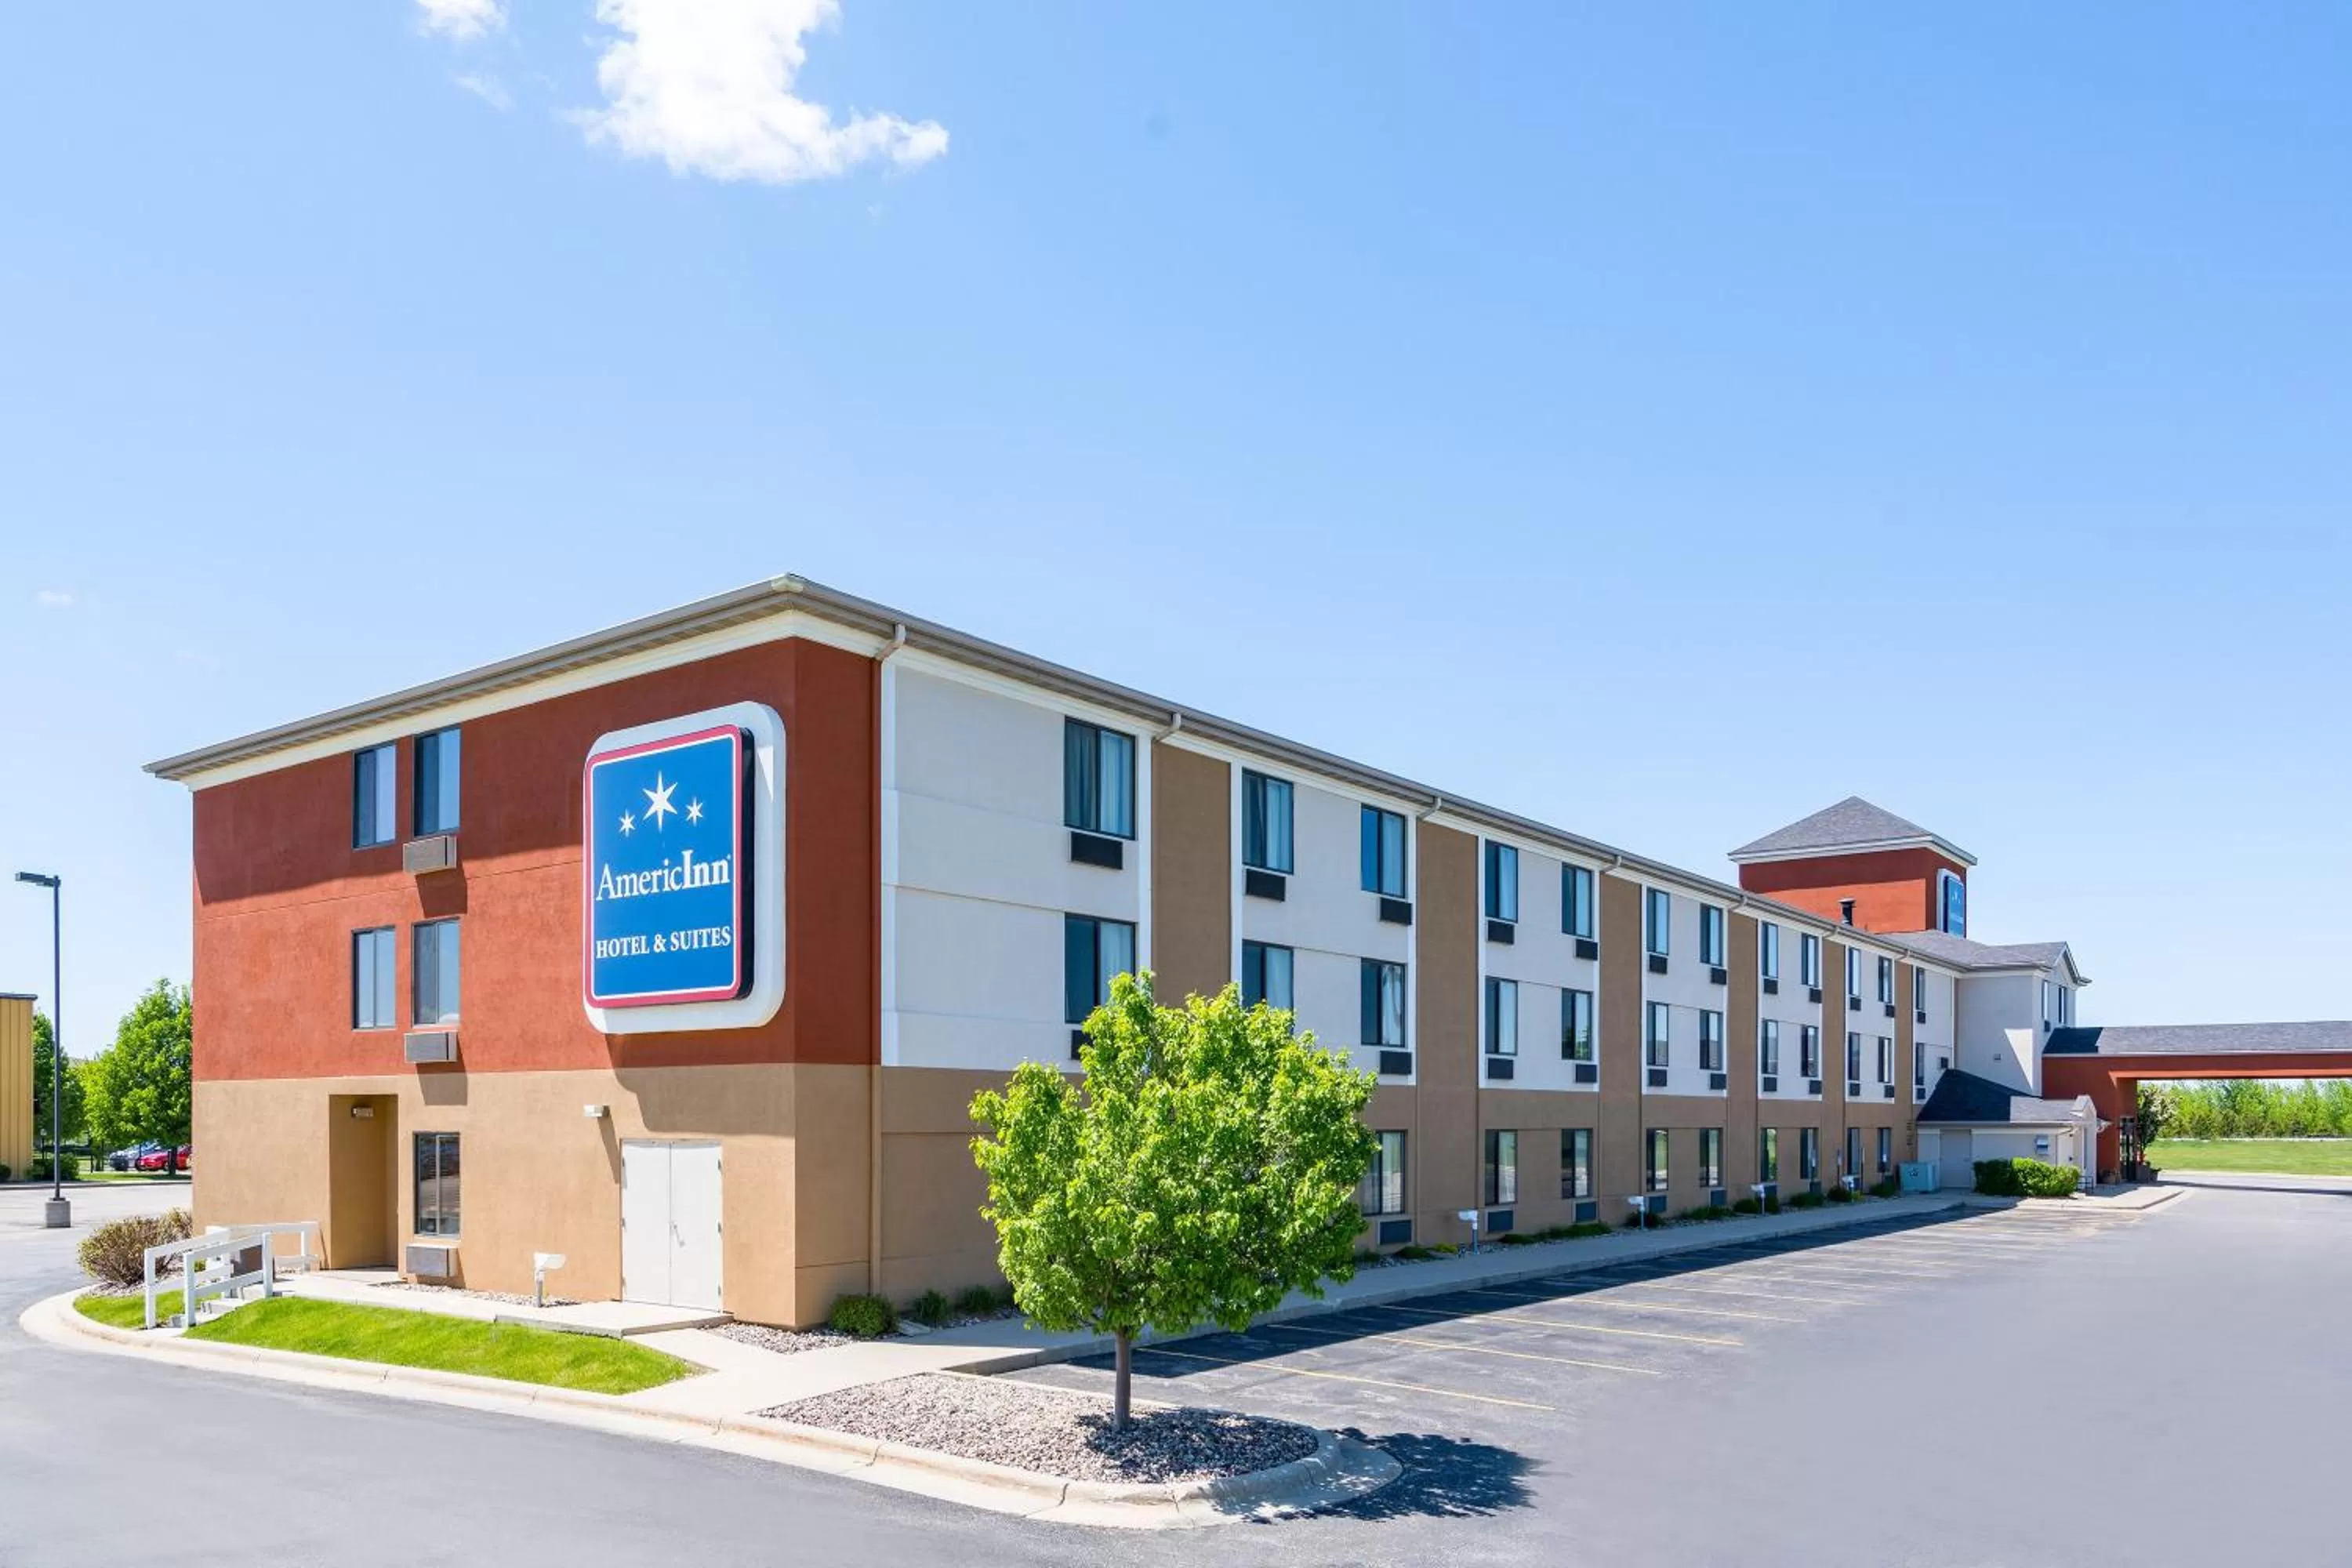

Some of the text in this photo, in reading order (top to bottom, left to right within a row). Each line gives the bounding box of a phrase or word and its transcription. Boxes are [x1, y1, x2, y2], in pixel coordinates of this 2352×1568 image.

[596, 849, 731, 901] AmericInn
[596, 926, 731, 959] HOTEL & SUITES
